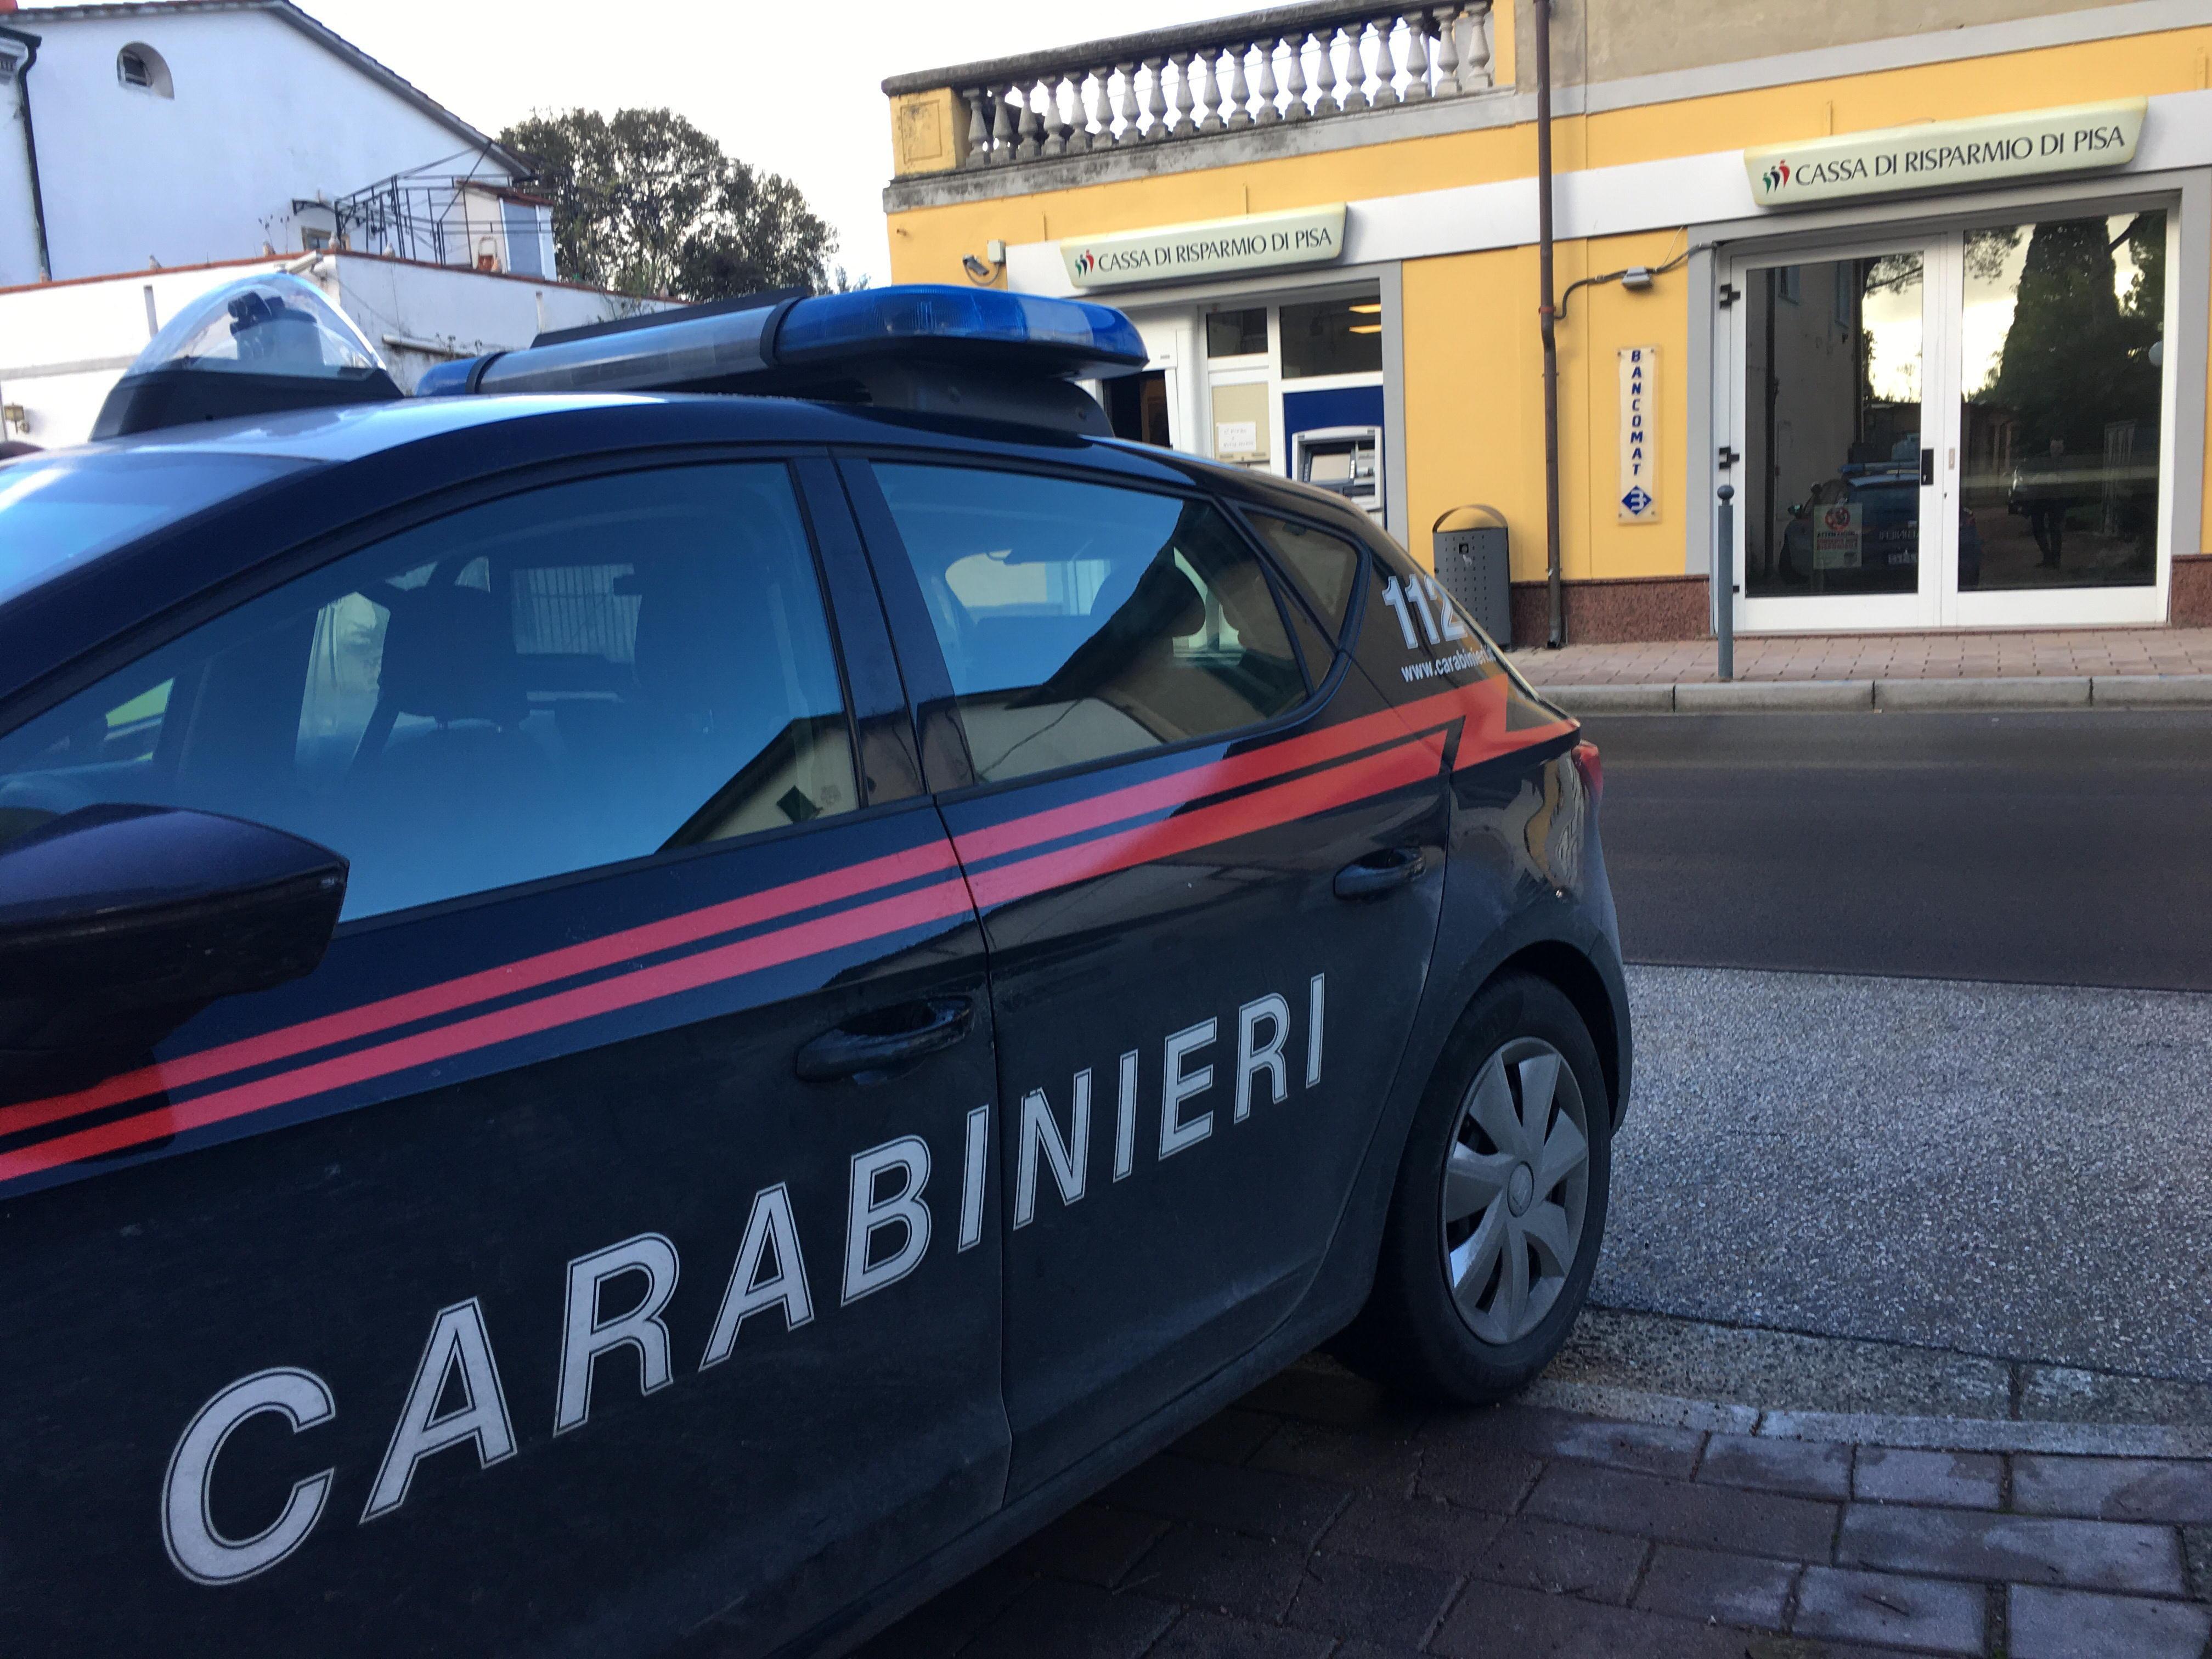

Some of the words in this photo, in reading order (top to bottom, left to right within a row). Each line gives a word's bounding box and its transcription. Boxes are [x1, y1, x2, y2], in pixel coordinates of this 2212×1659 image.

[1795, 157, 1868, 185] CASSA
[1875, 154, 1897, 177] DI
[1905, 137, 2033, 173] RISPARMIO
[2041, 132, 2064, 156] DI
[2074, 126, 2125, 153] PISA
[1098, 249, 1152, 273] CASSA
[1155, 246, 1171, 266] DI
[1176, 234, 1267, 263] RISPARMIO
[1272, 232, 1289, 252] DI
[1295, 227, 1332, 250] PISA
[1630, 349, 1643, 476] BANCOMAT
[1381, 574, 1468, 650] 112
[161, 972, 1325, 1585] CARABINIERI
